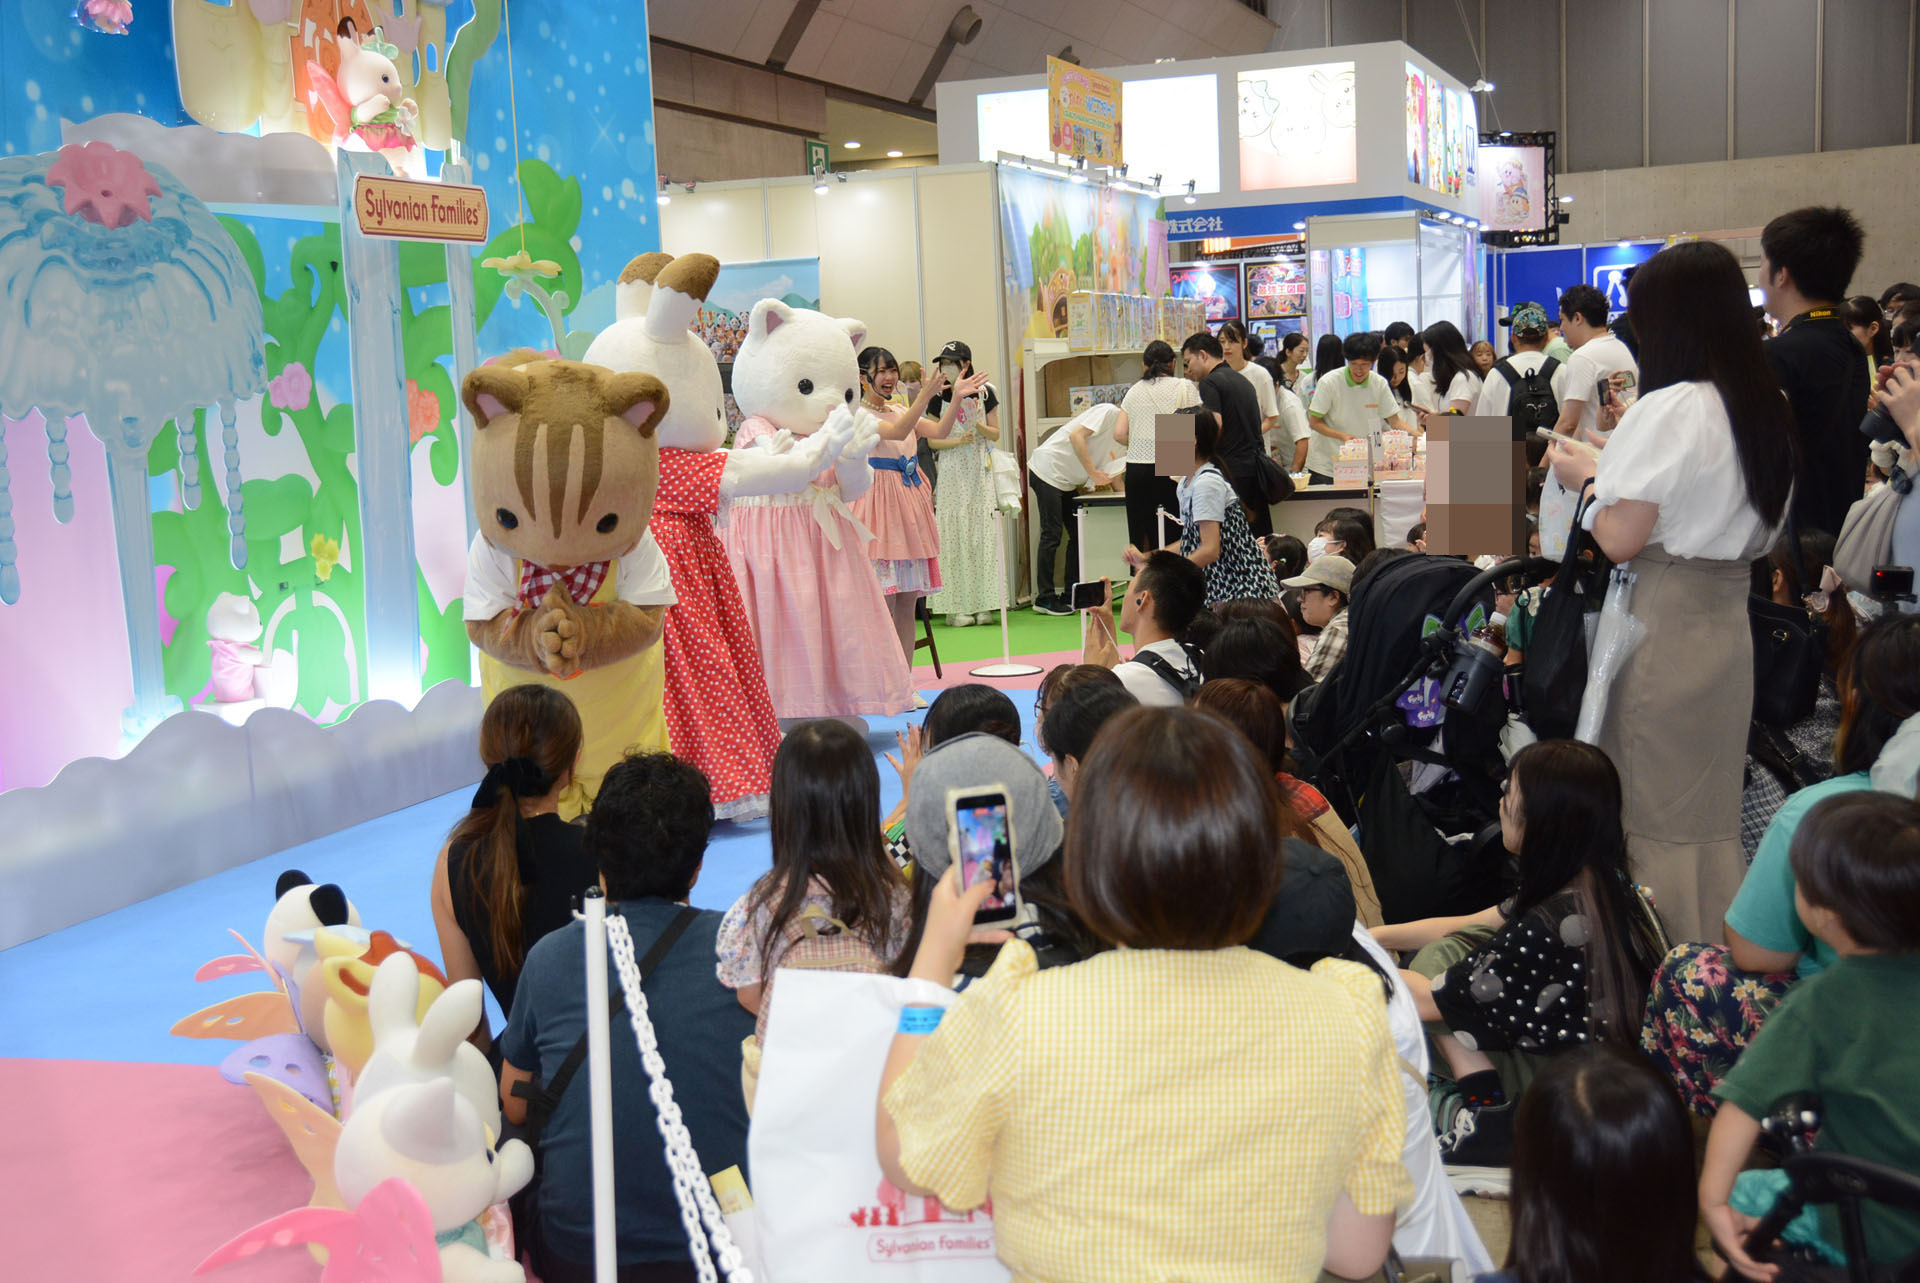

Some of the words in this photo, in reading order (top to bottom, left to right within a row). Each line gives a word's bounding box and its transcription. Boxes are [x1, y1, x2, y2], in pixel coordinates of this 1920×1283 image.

[365, 188, 428, 226] Sylvanian
[1810, 310, 1831, 318] Nikon
[876, 1238, 935, 1257] Sylvanian
[939, 1235, 990, 1250] Families
